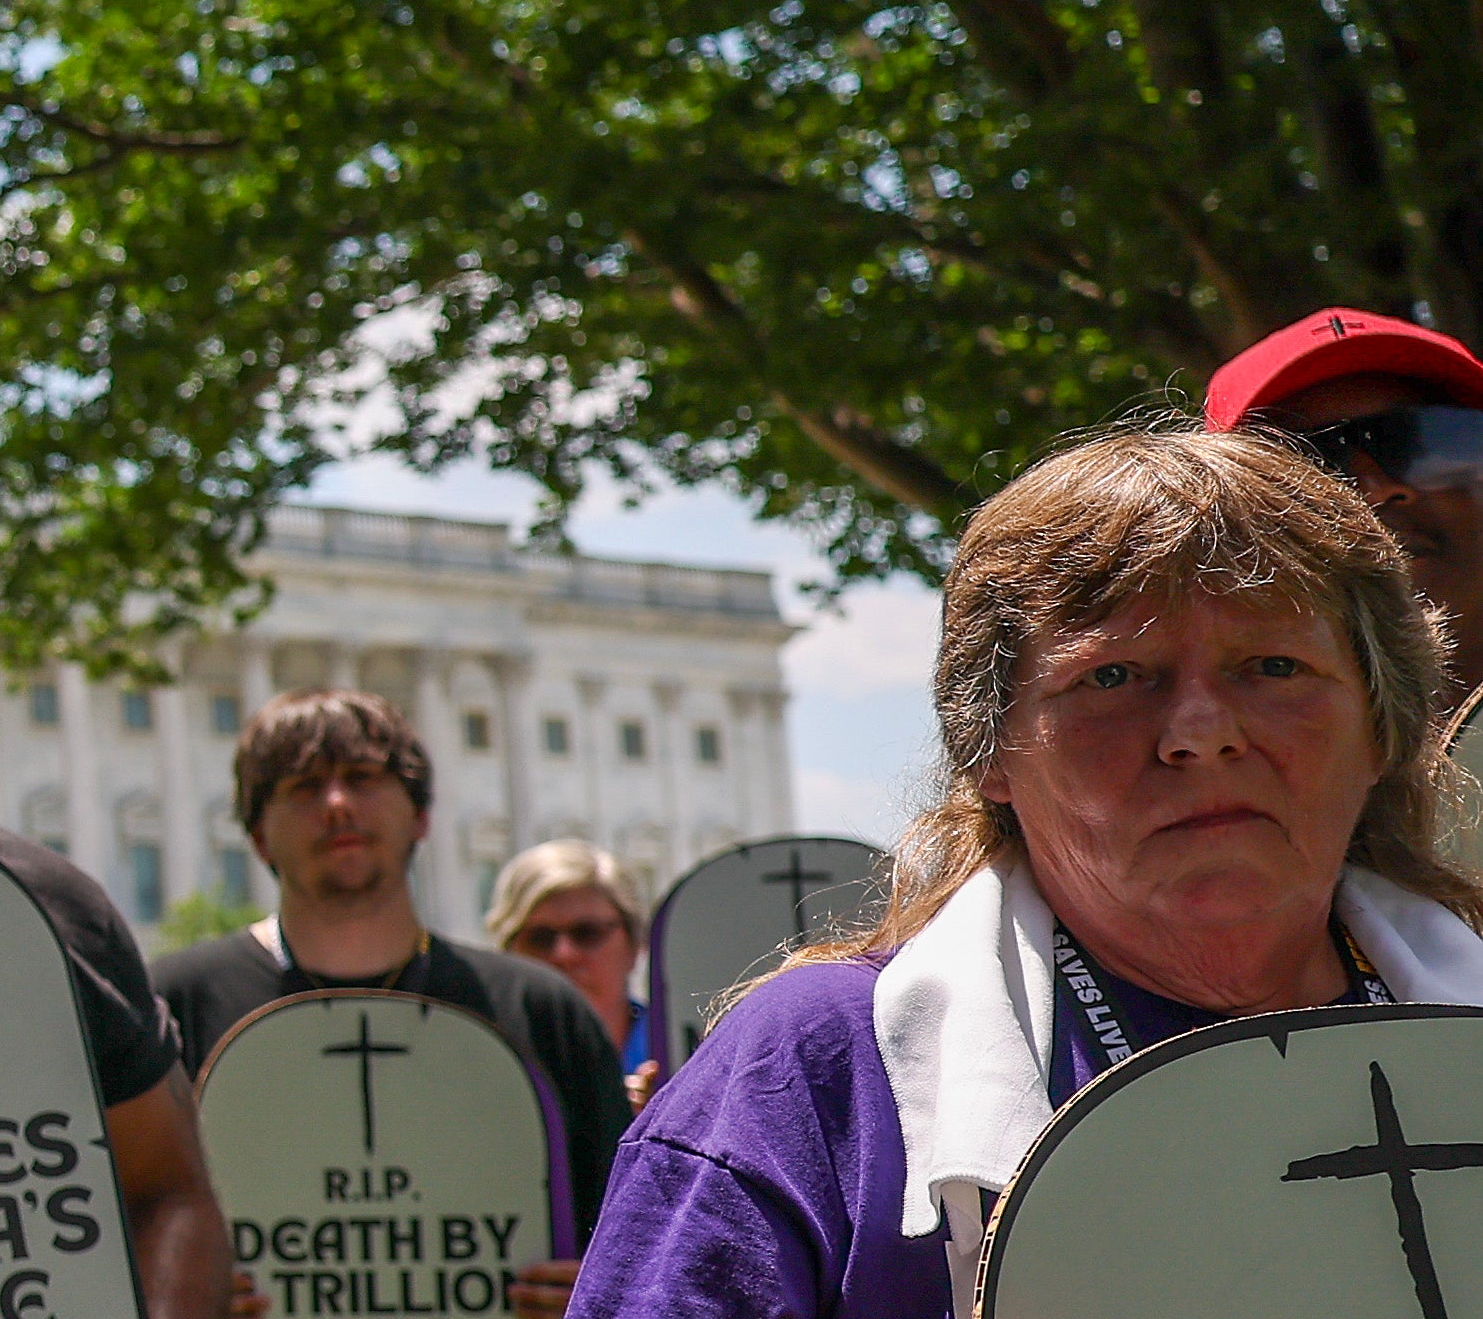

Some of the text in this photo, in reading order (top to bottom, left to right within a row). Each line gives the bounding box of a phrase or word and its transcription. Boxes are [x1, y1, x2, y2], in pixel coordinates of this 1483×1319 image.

[324, 1166, 422, 1203] R.I.P.
[232, 1215, 520, 1263] DEATH BY
